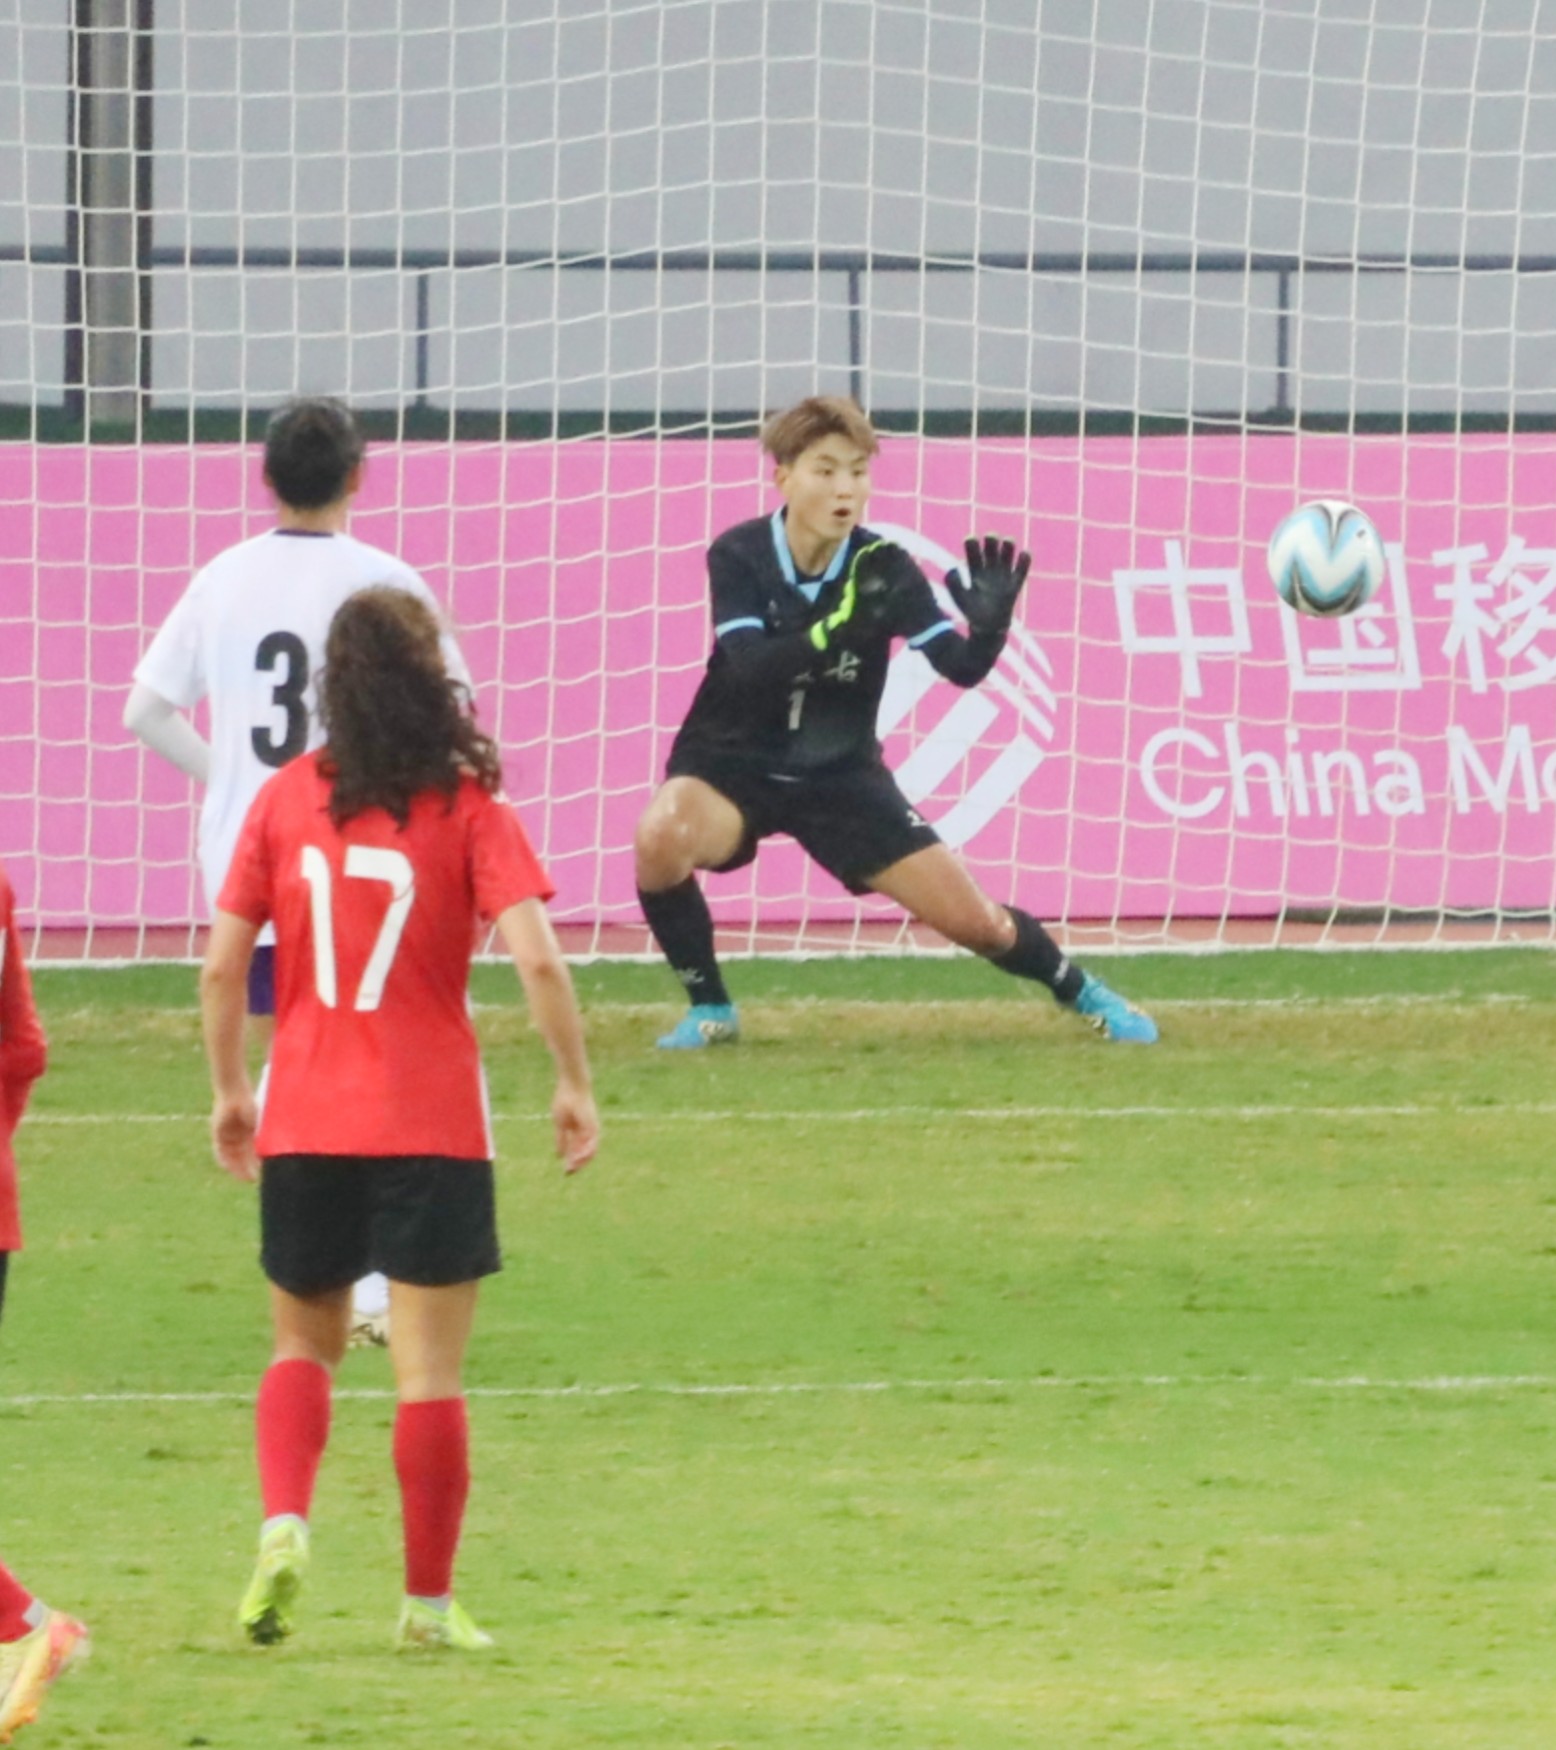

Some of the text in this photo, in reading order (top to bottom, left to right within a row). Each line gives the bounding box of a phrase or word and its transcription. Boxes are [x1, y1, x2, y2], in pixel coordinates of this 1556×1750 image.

[251, 631, 309, 768] 3
[788, 690, 805, 730] 1
[1140, 722, 1425, 819] China
[301, 844, 417, 1011] 17
